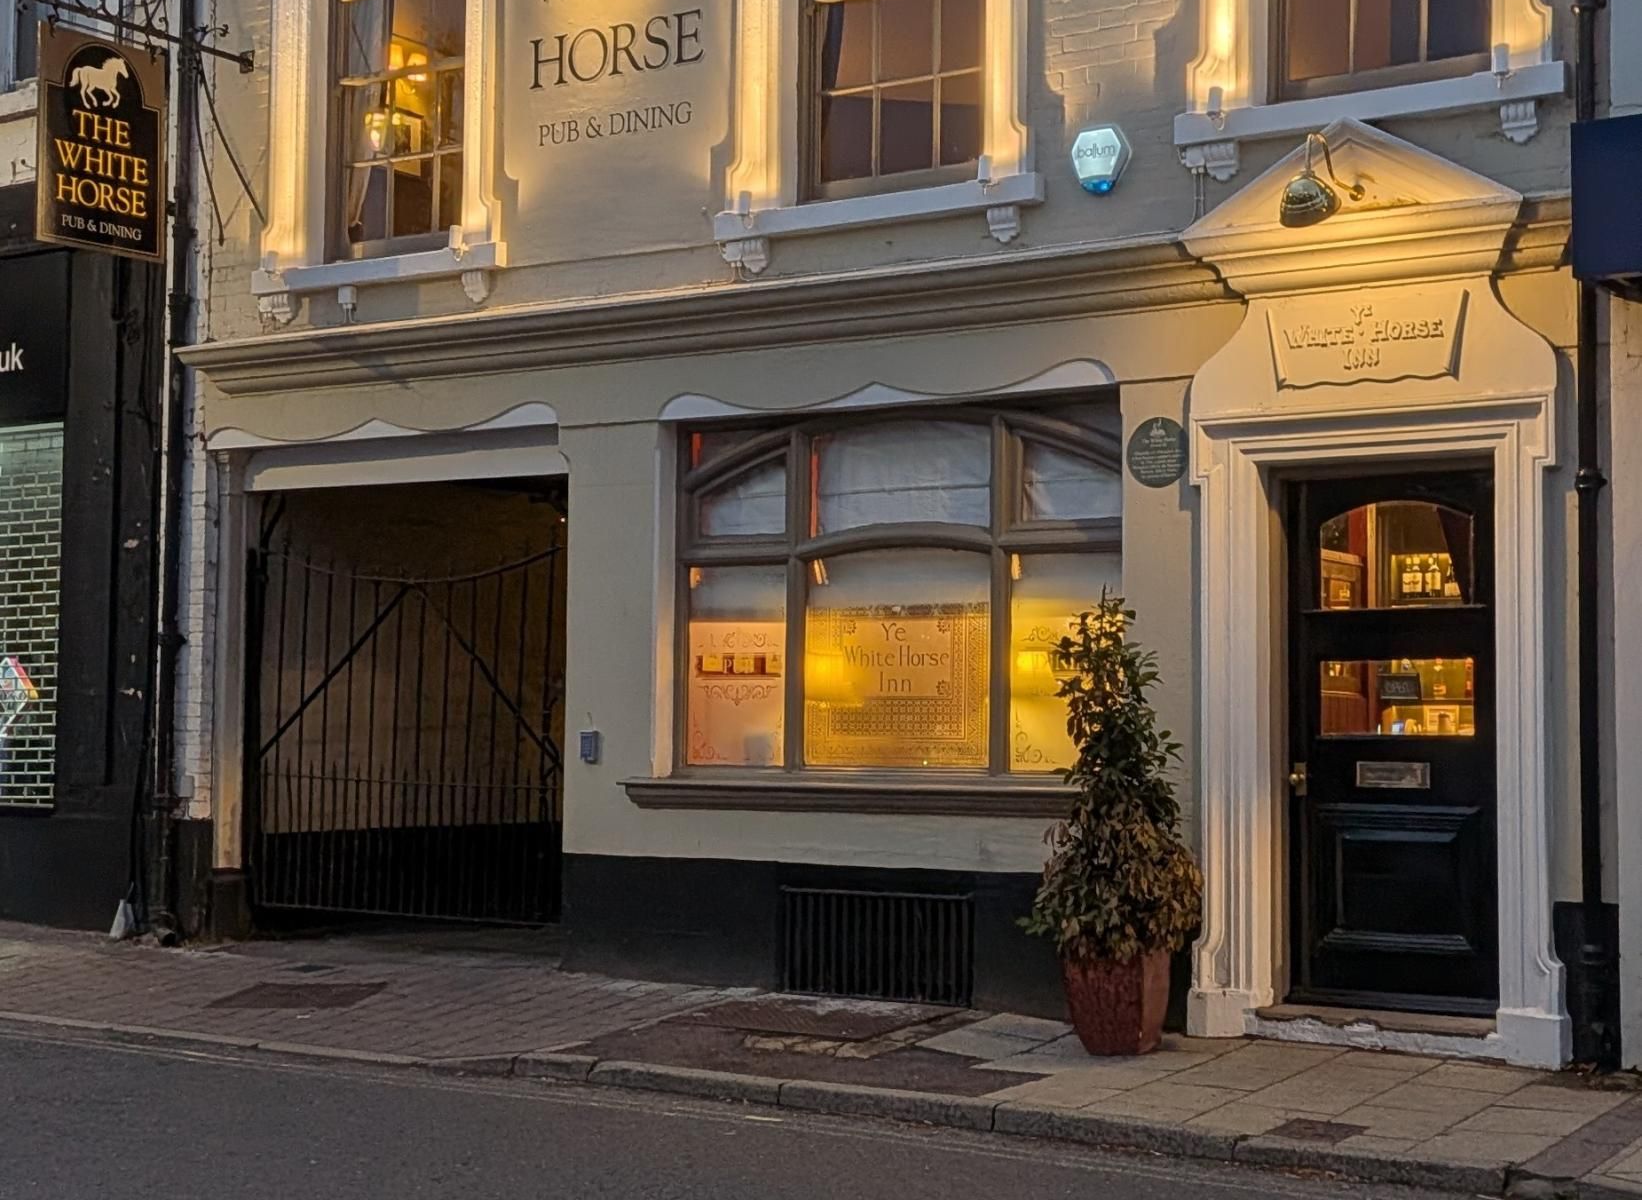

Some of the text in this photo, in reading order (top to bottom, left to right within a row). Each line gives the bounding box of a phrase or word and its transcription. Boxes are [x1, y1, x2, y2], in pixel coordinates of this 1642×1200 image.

[529, 9, 705, 90] HORSE
[72, 109, 131, 148] THE
[539, 101, 692, 147] PUB & DINING
[54, 138, 149, 185] WHITE
[56, 173, 148, 218] HORSE
[61, 214, 142, 241] PUB & DINING
[1371, 319, 1445, 343] HORSE
[1343, 347, 1380, 371] INN
[881, 622, 906, 642] Ye
[844, 644, 949, 670] White Horse
[879, 671, 912, 693] Inn
